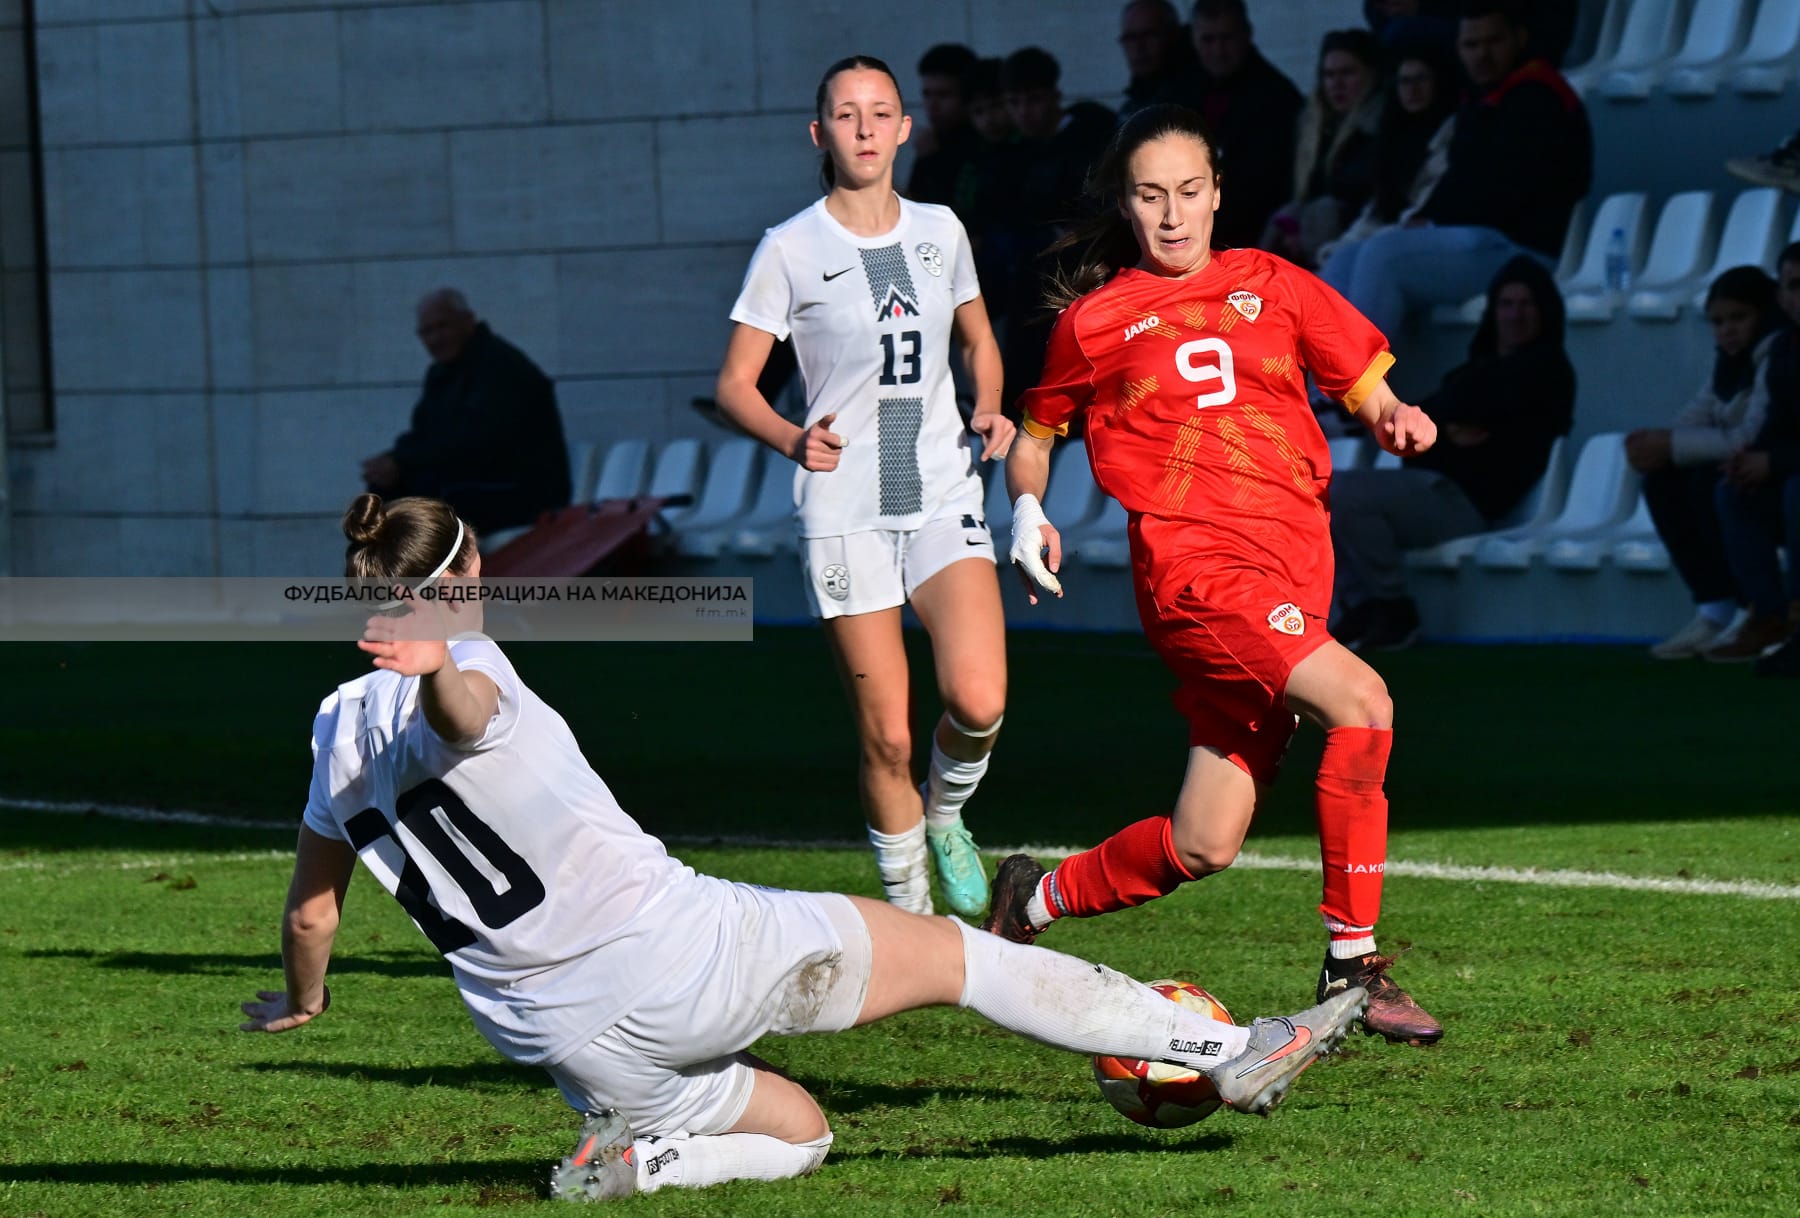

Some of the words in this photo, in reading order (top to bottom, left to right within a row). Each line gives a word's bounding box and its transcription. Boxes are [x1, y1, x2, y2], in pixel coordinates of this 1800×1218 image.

[1124, 316, 1160, 341] JAKO
[879, 331, 922, 386] 13
[1175, 338, 1237, 409] 9
[344, 778, 546, 955] 20
[1344, 863, 1384, 874] JAKO
